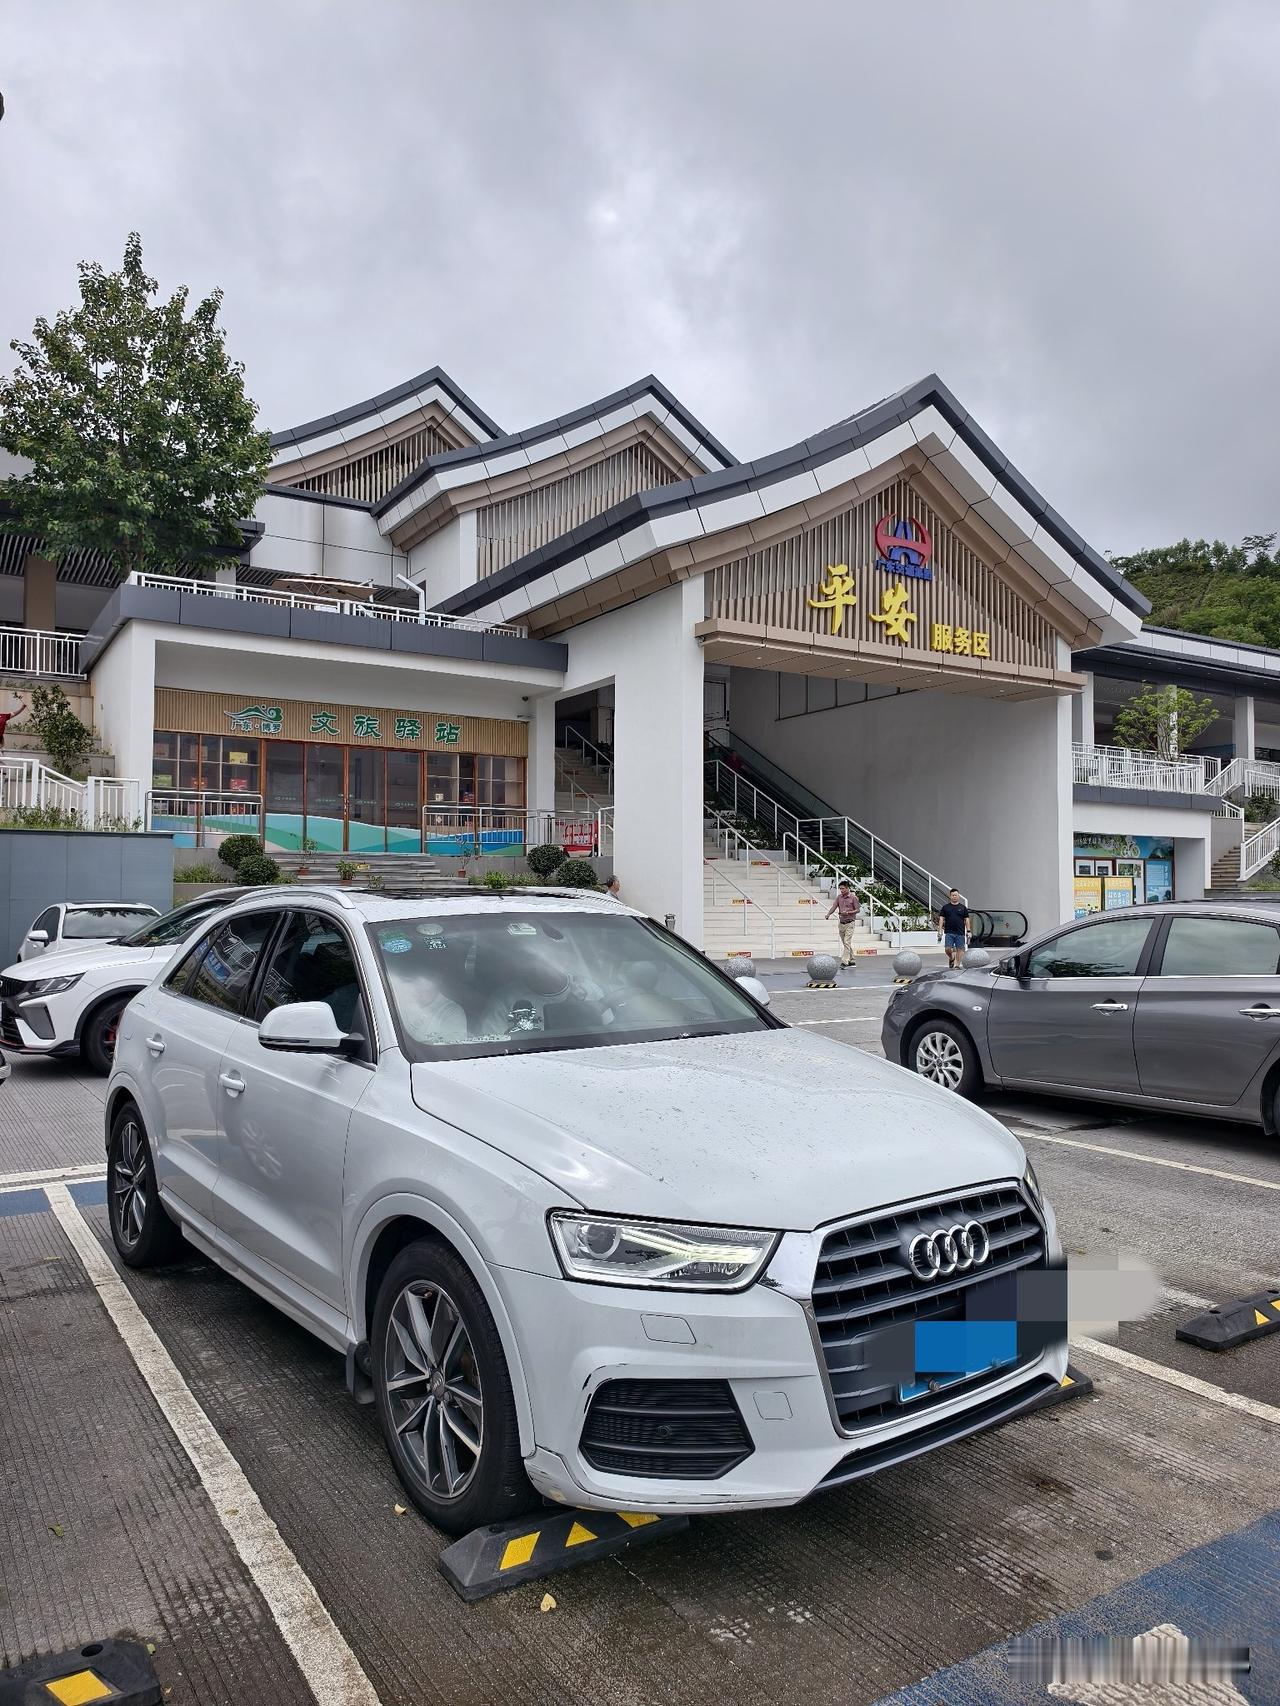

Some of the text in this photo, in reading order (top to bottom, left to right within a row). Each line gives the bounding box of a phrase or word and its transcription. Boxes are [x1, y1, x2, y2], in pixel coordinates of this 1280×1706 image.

[808, 564, 990, 657] 平安 服务区
[310, 712, 460, 744] 文旅驿站
